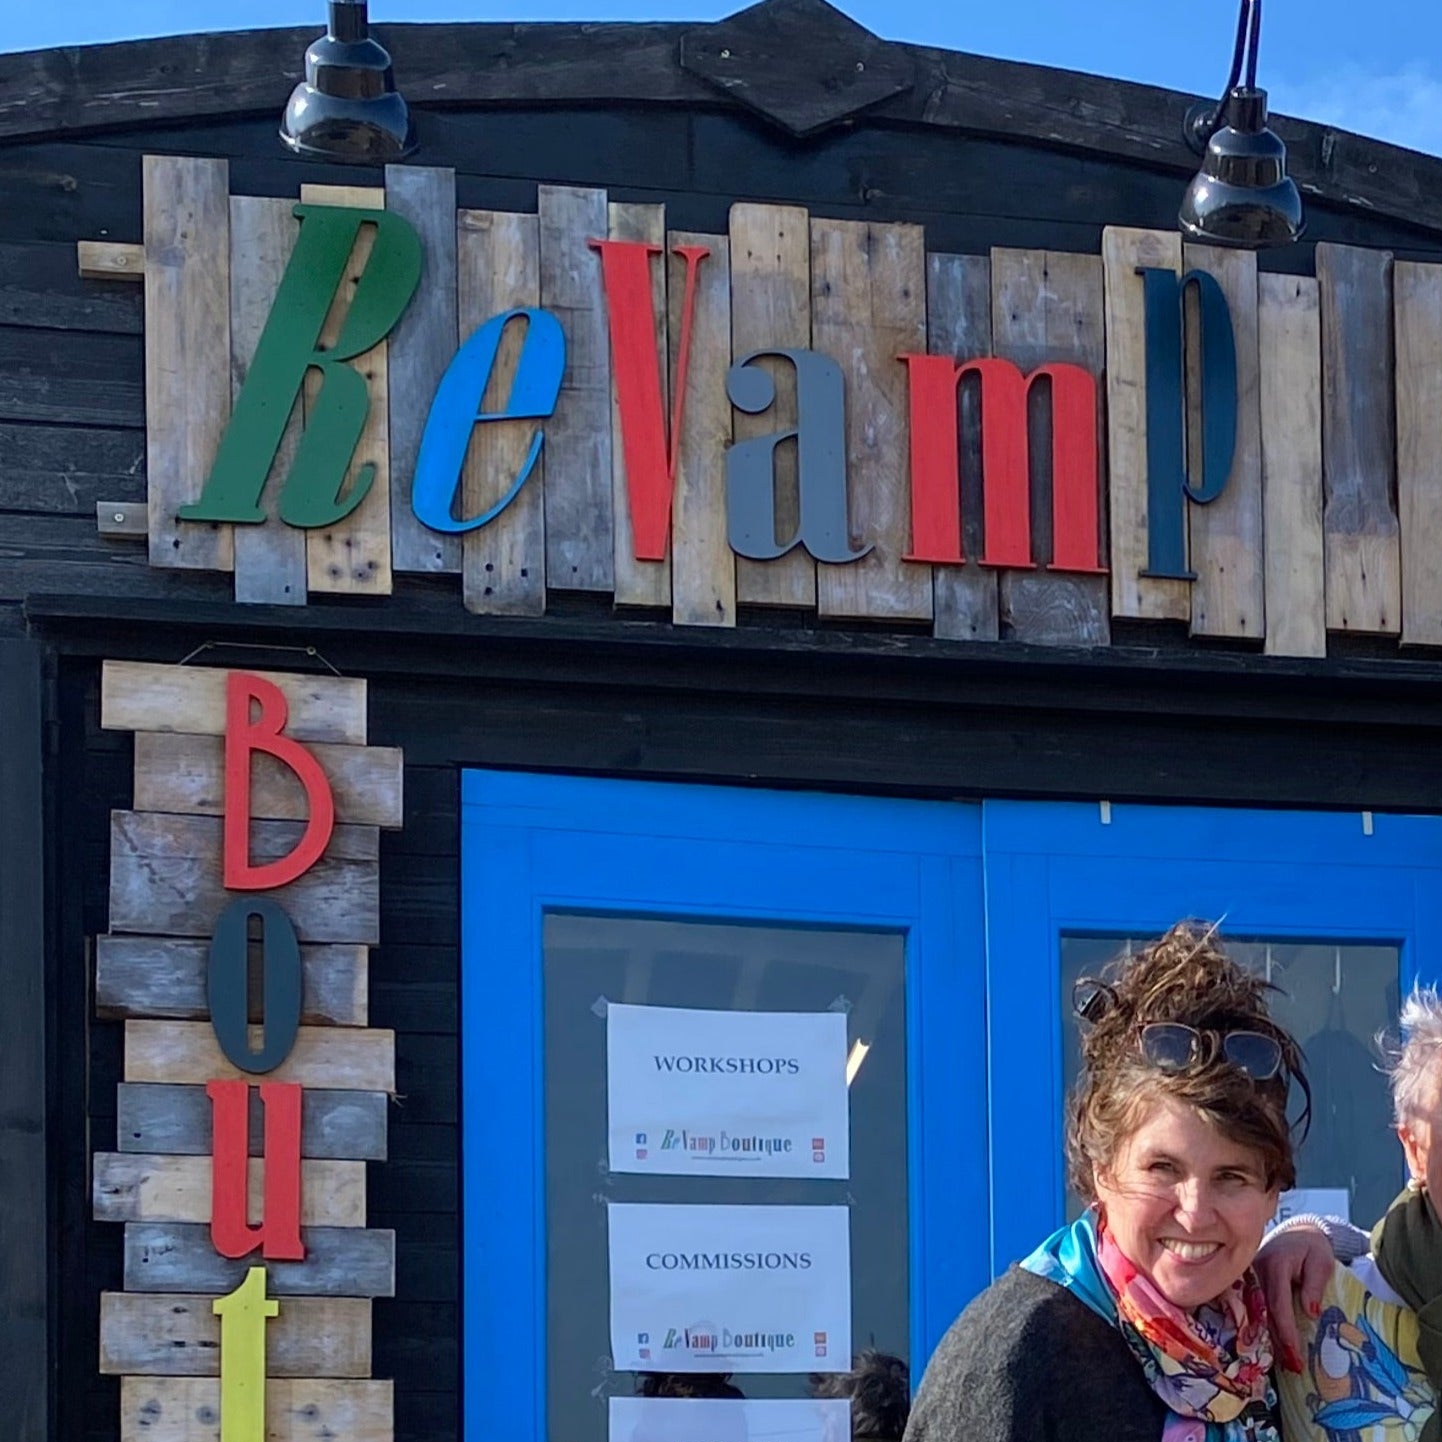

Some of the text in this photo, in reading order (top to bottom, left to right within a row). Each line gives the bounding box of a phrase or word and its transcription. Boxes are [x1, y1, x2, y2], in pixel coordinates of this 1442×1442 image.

[177, 203, 1237, 581] ReVamp
[653, 1055, 800, 1075] WORKSHOPS
[720, 1130, 793, 1156] Boutique
[646, 1252, 812, 1270] COMMISSIONS
[722, 1327, 795, 1352] Boutique
